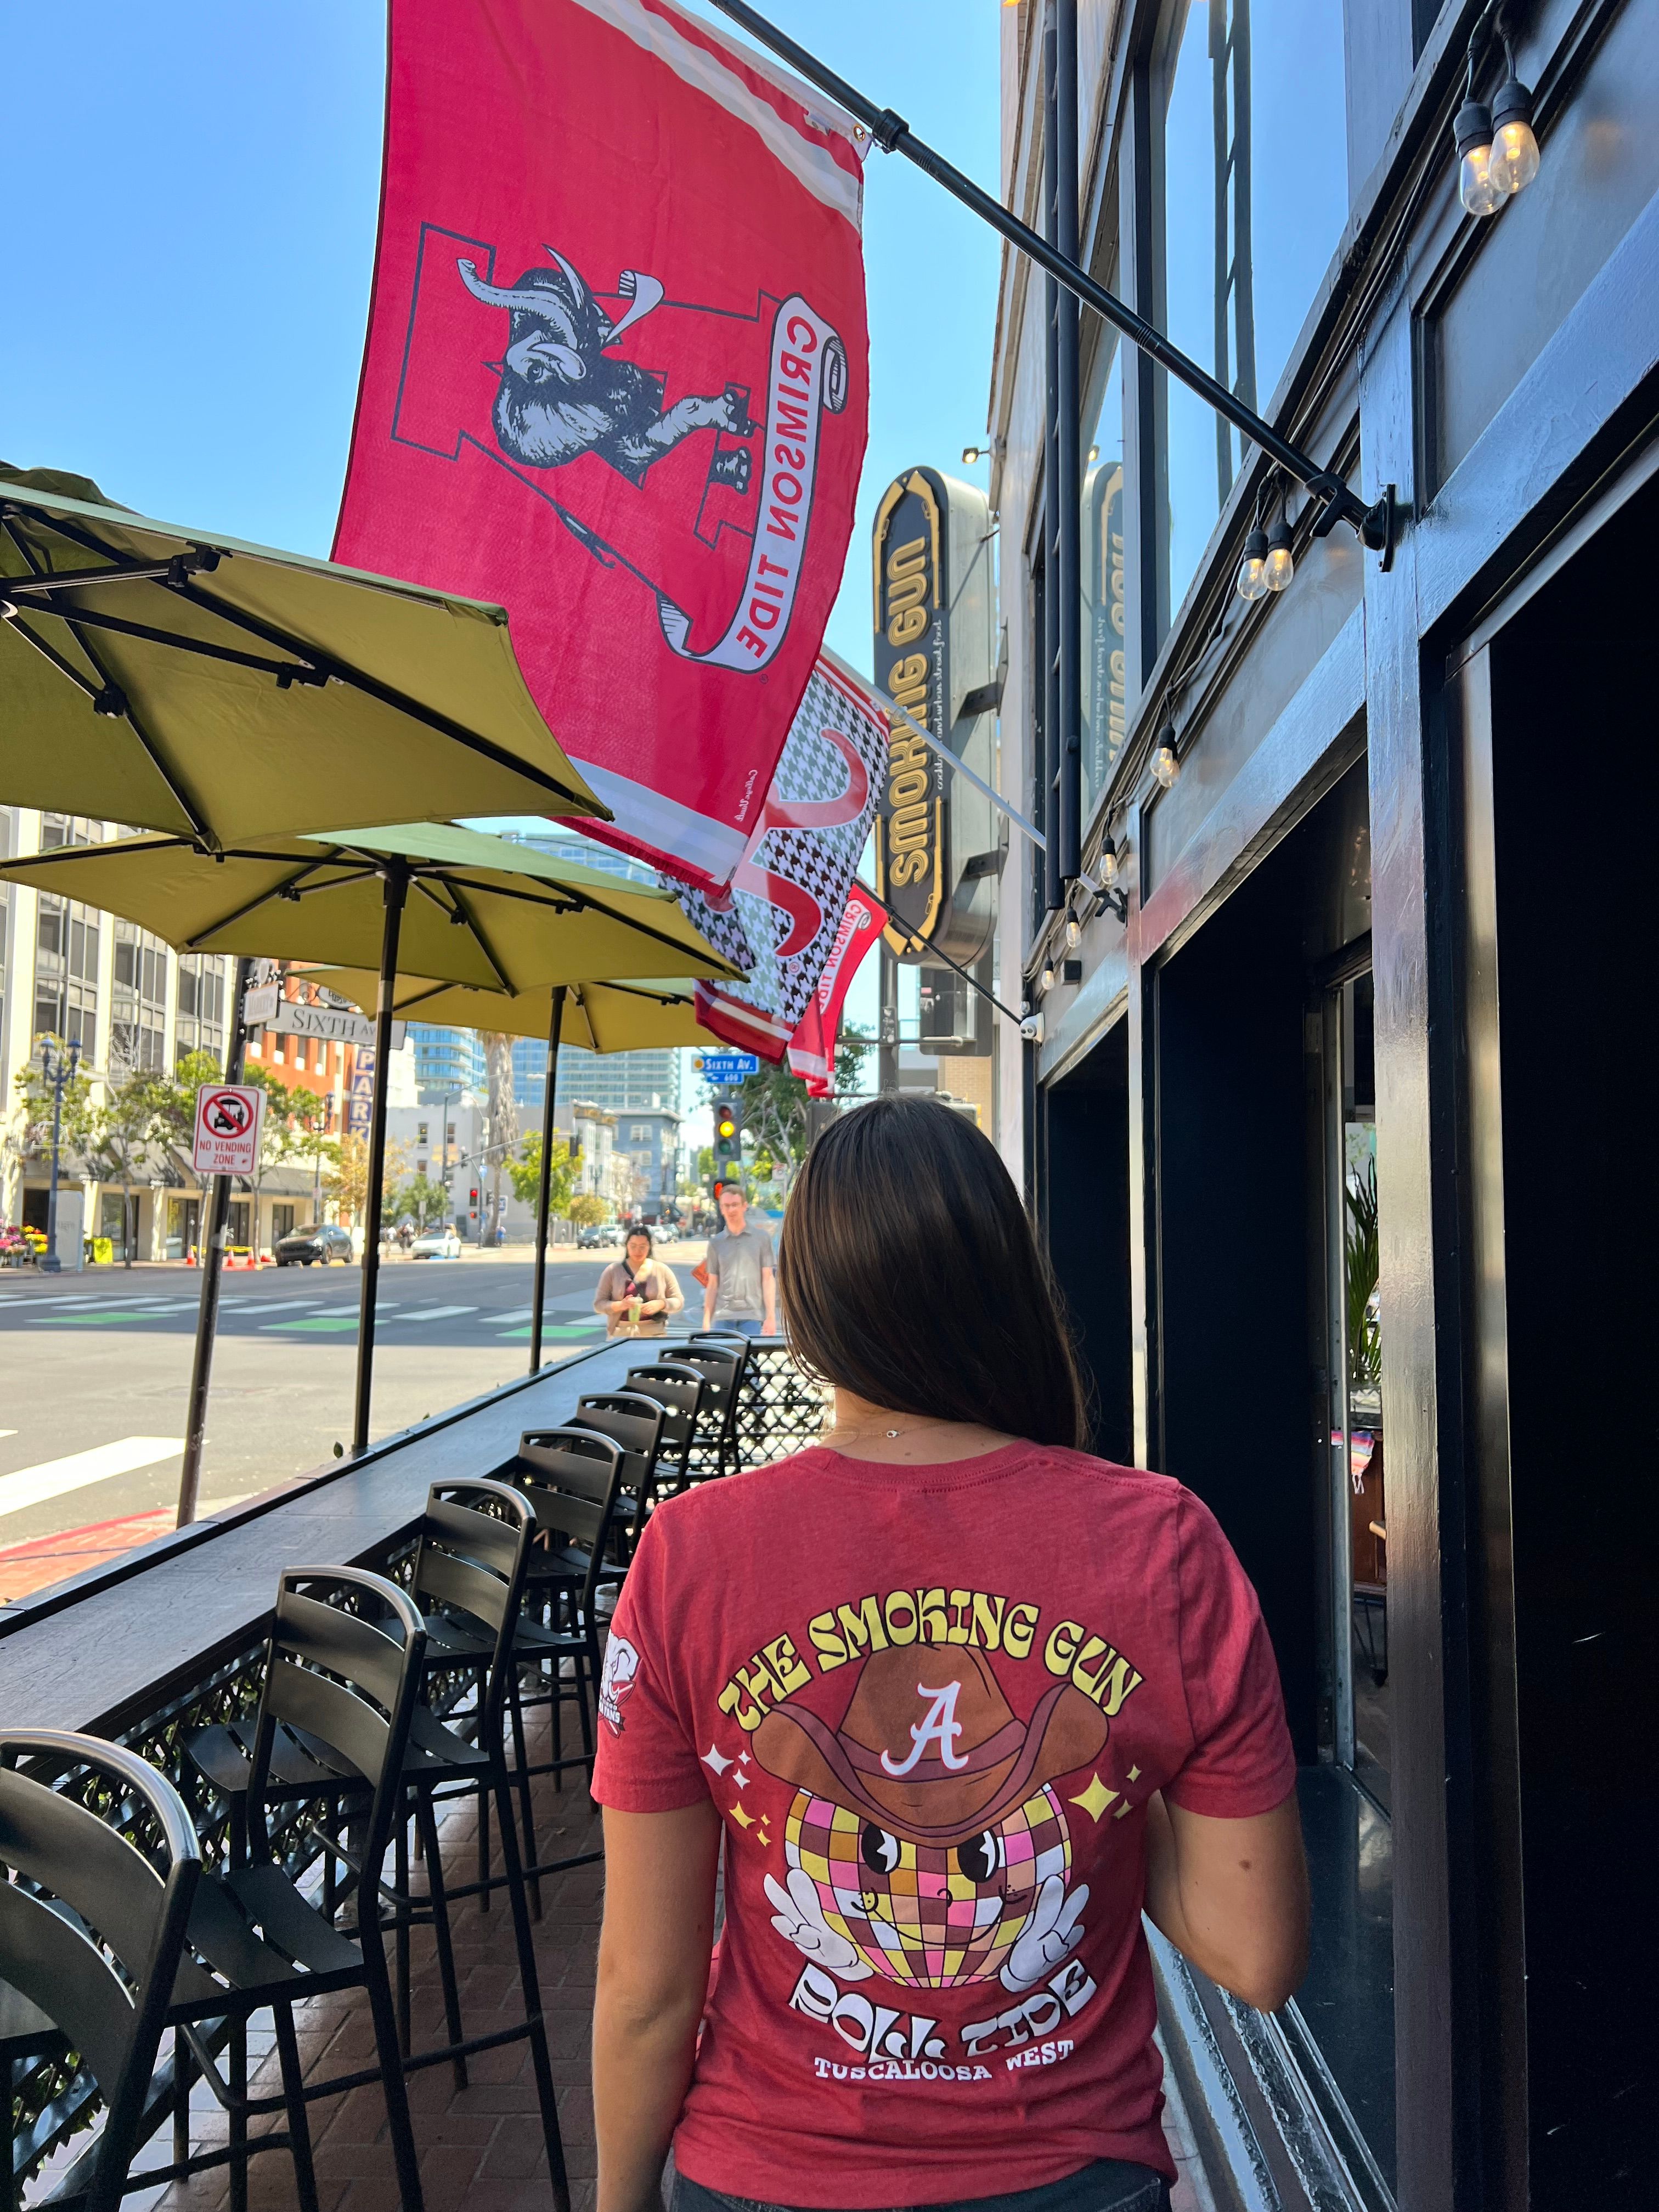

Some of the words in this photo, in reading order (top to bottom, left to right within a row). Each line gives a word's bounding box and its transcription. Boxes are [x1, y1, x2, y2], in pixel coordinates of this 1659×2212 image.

[887, 535, 928, 647] GUN
[888, 652, 930, 887] SMOKING
[292, 1008, 357, 1036] SIXTH
[706, 1058, 734, 1070] SIXTH
[200, 1139, 211, 1150] NO
[215, 1141, 251, 1153] VENDING
[213, 1153, 235, 1165] ZONE
[717, 1632, 813, 1732] THE
[807, 1587, 1040, 1673] SMOKING
[1044, 1620, 1143, 1717] GUN
[788, 1961, 947, 2063] ROLL
[960, 1957, 1097, 2057] TIDE
[814, 2056, 993, 2081] TUSCALOOSA
[1005, 2039, 1074, 2072] WEST
